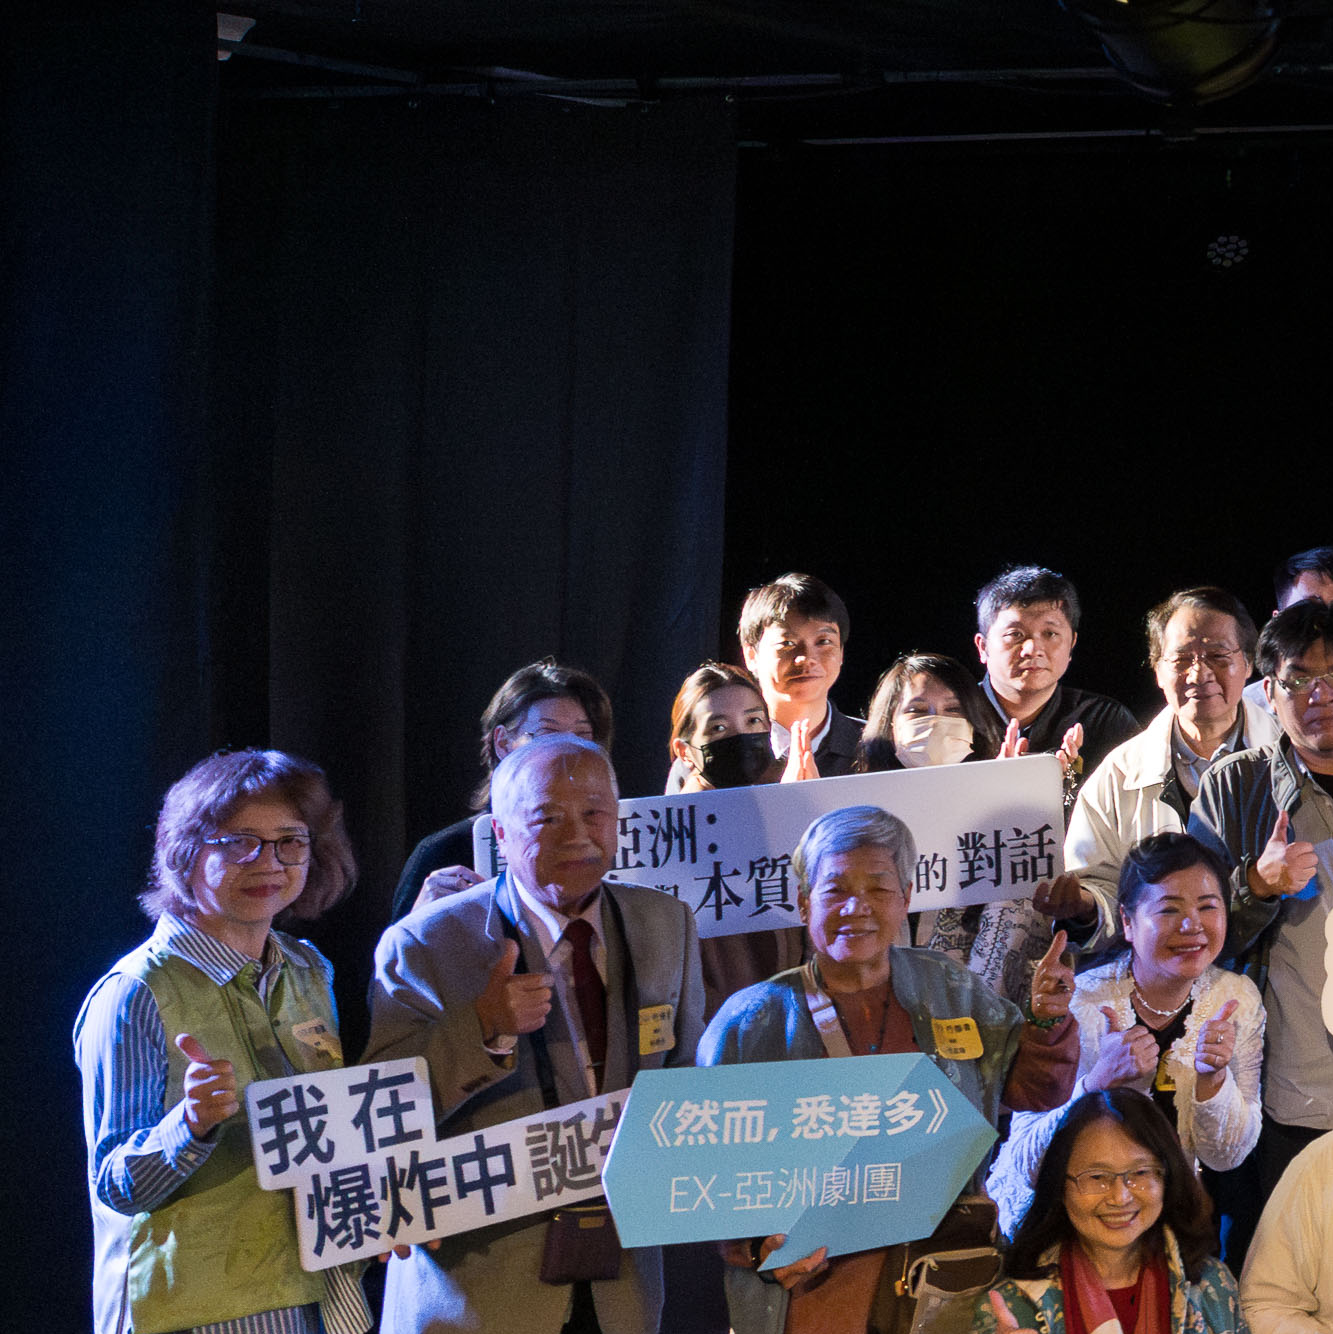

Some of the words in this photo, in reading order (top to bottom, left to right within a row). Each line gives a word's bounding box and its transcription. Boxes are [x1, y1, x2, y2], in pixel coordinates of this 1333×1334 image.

[256, 1068, 424, 1177] 我在
[670, 1162, 902, 1213] EX-亞洲劇團
